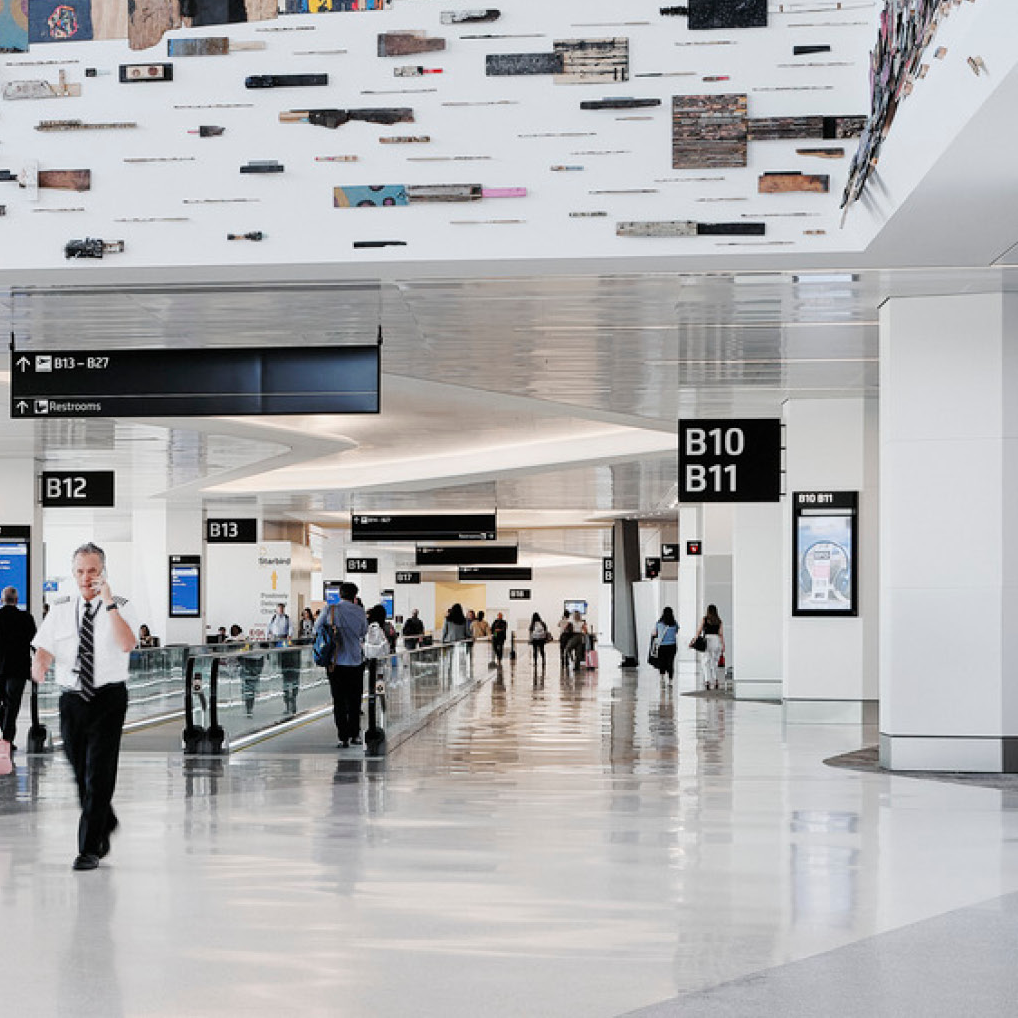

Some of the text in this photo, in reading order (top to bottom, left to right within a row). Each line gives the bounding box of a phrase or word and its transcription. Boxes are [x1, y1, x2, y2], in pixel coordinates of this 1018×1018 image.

[54, 357, 75, 369] B13
[87, 357, 109, 369] B27
[49, 400, 102, 412] Restrooms
[685, 428, 745, 456] B10
[685, 464, 737, 492] B11
[46, 478, 87, 498] B12
[798, 494, 833, 503] B10 B11
[210, 522, 239, 538] B13
[258, 557, 291, 566] Starbird
[348, 560, 367, 570] B14
